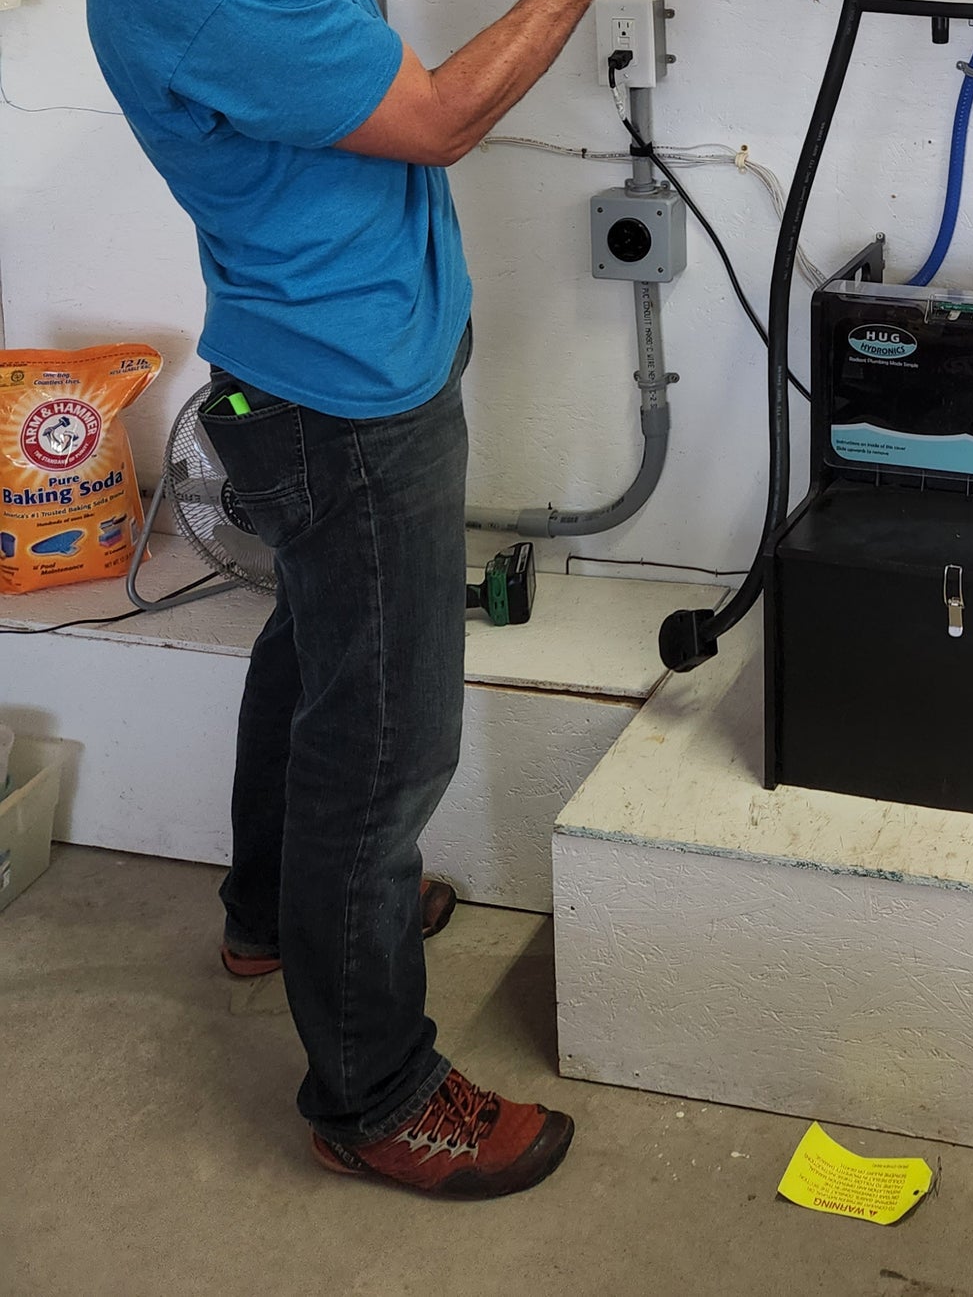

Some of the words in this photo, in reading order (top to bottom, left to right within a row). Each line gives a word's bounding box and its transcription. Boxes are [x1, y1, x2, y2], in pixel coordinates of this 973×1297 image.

[643, 301, 652, 325] CONDUIT
[866, 331, 900, 342] HUG
[860, 343, 906, 355] HYDRONICS
[120, 360, 134, 369] 12
[26, 415, 42, 445] ARM
[41, 407, 52, 418] &
[54, 402, 98, 436] HAMMER
[48, 475, 80, 487] Pure
[2, 487, 73, 505] Baking
[80, 470, 123, 497] Soda
[41, 508, 67, 517] Trusted
[68, 504, 92, 513] Baking
[93, 498, 109, 507] Soda
[40, 562, 56, 570] Pool
[41, 564, 84, 575] Maintenance
[813, 1197, 865, 1215] WARNING
